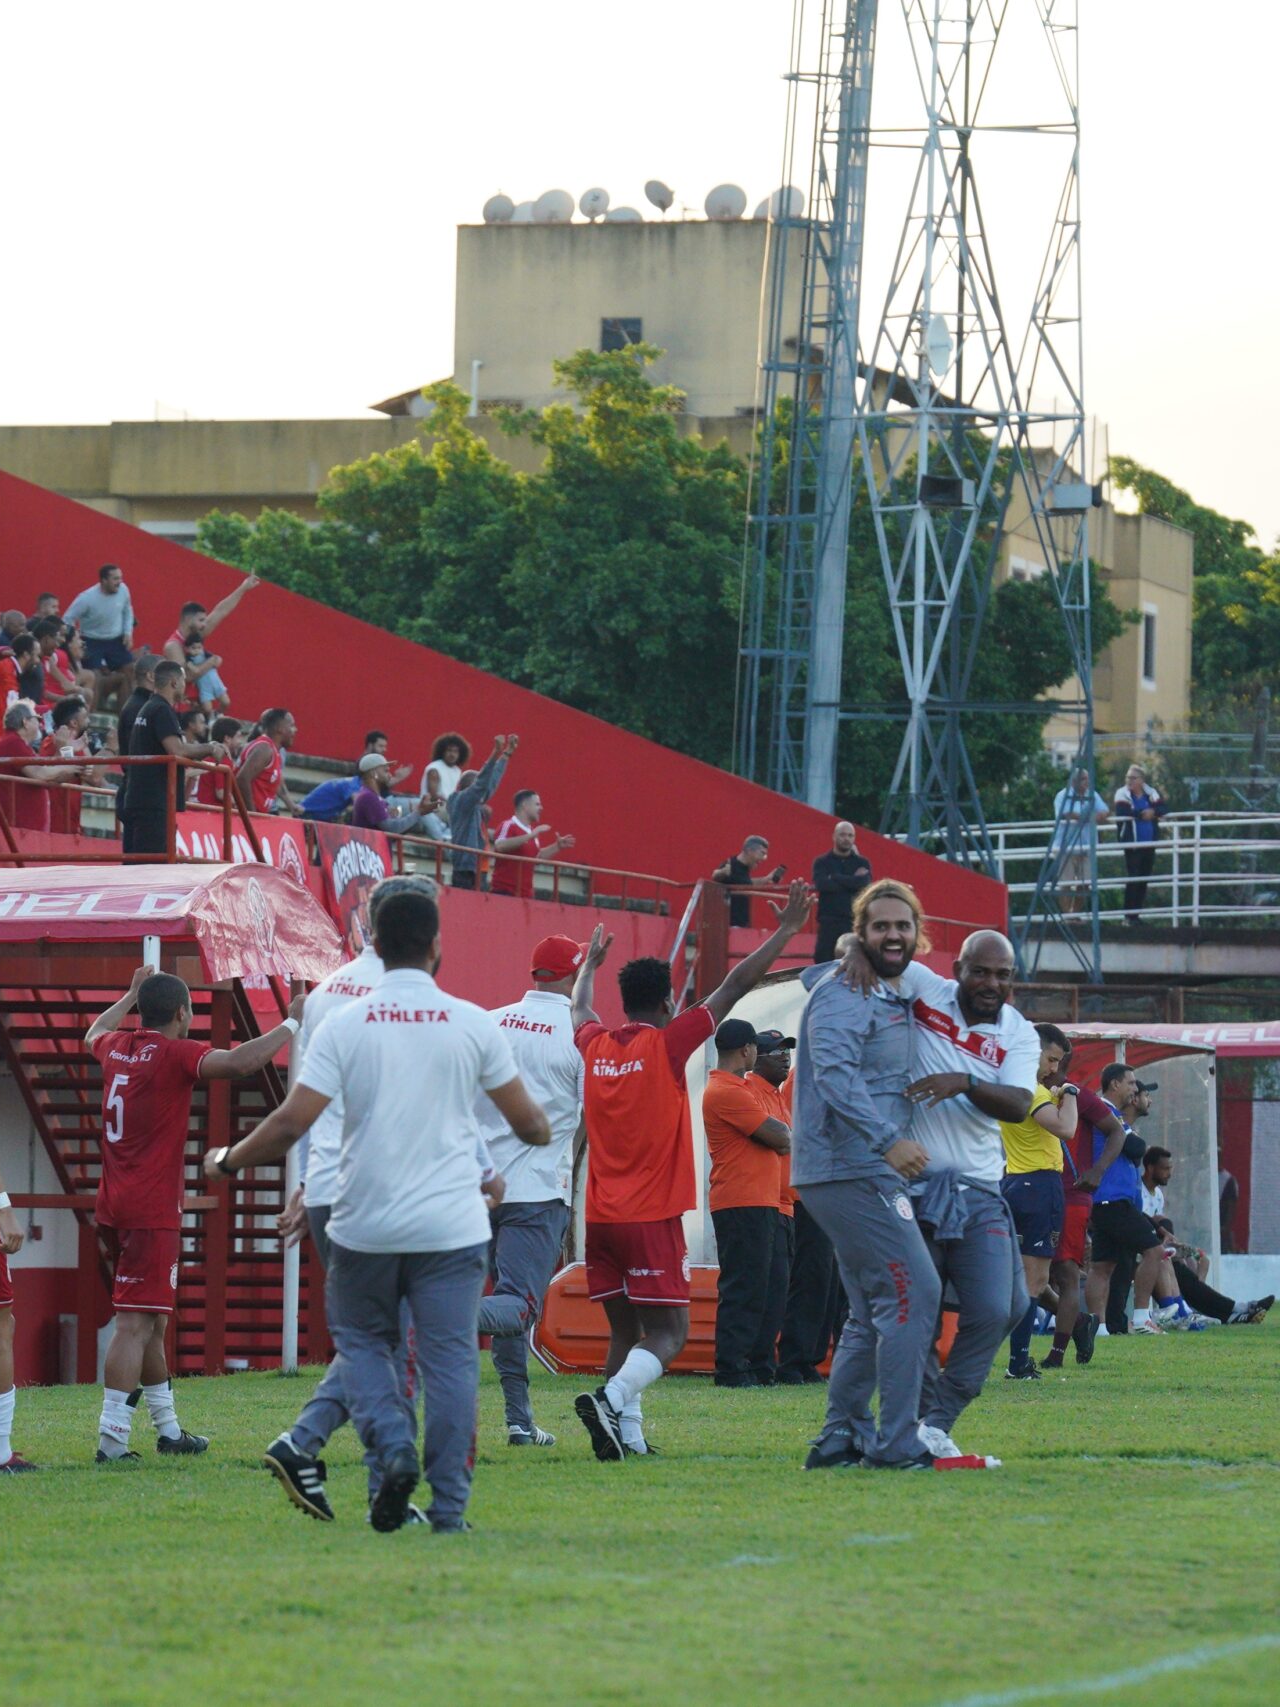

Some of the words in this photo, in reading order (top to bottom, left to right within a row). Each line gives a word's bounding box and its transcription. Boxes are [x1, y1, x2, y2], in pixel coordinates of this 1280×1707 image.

[326, 983, 372, 997] ATHLET
[365, 1010, 448, 1023] ATHLETA
[500, 1018, 553, 1035] ATHLETA
[593, 1060, 642, 1077] ATHLETA
[106, 1073, 130, 1143] 5
